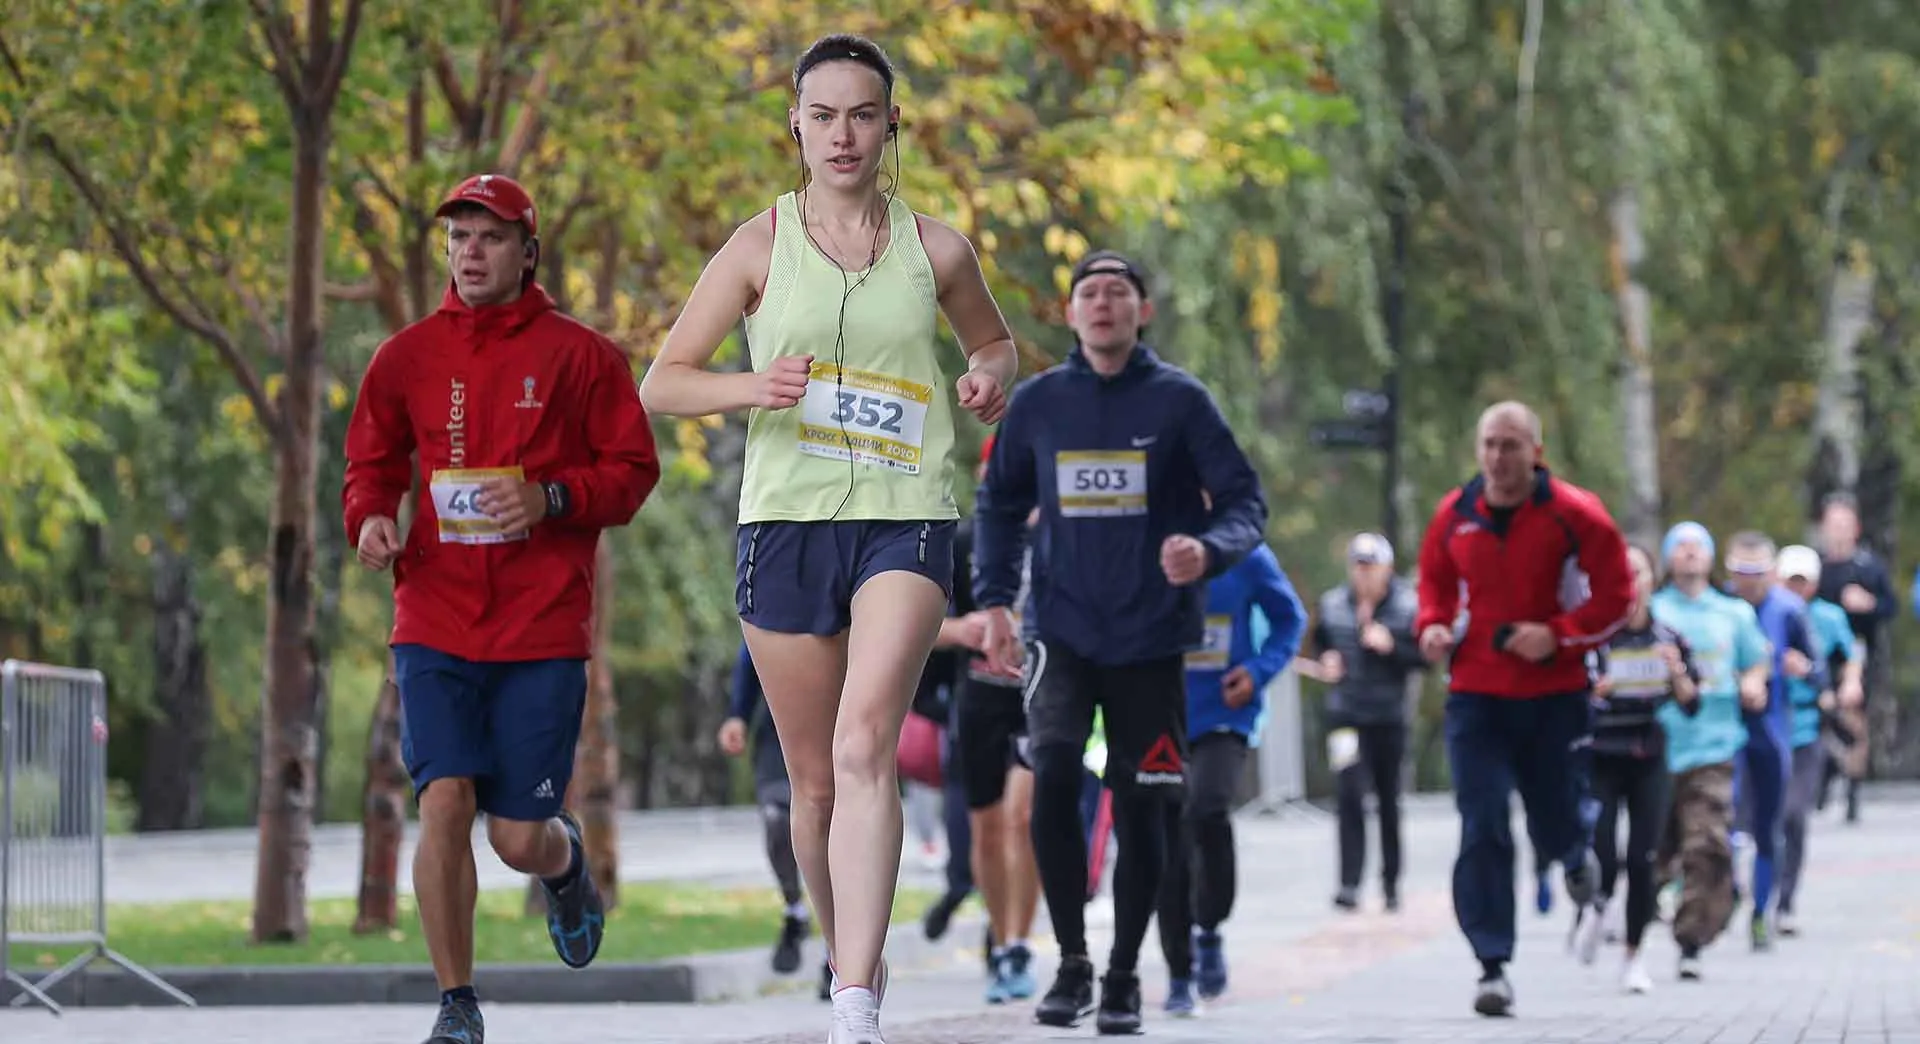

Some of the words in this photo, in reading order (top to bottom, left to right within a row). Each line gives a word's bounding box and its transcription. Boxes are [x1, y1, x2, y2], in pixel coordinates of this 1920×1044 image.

[830, 391, 903, 434] 352
[887, 443, 915, 459] 2020
[1074, 468, 1128, 491] 503
